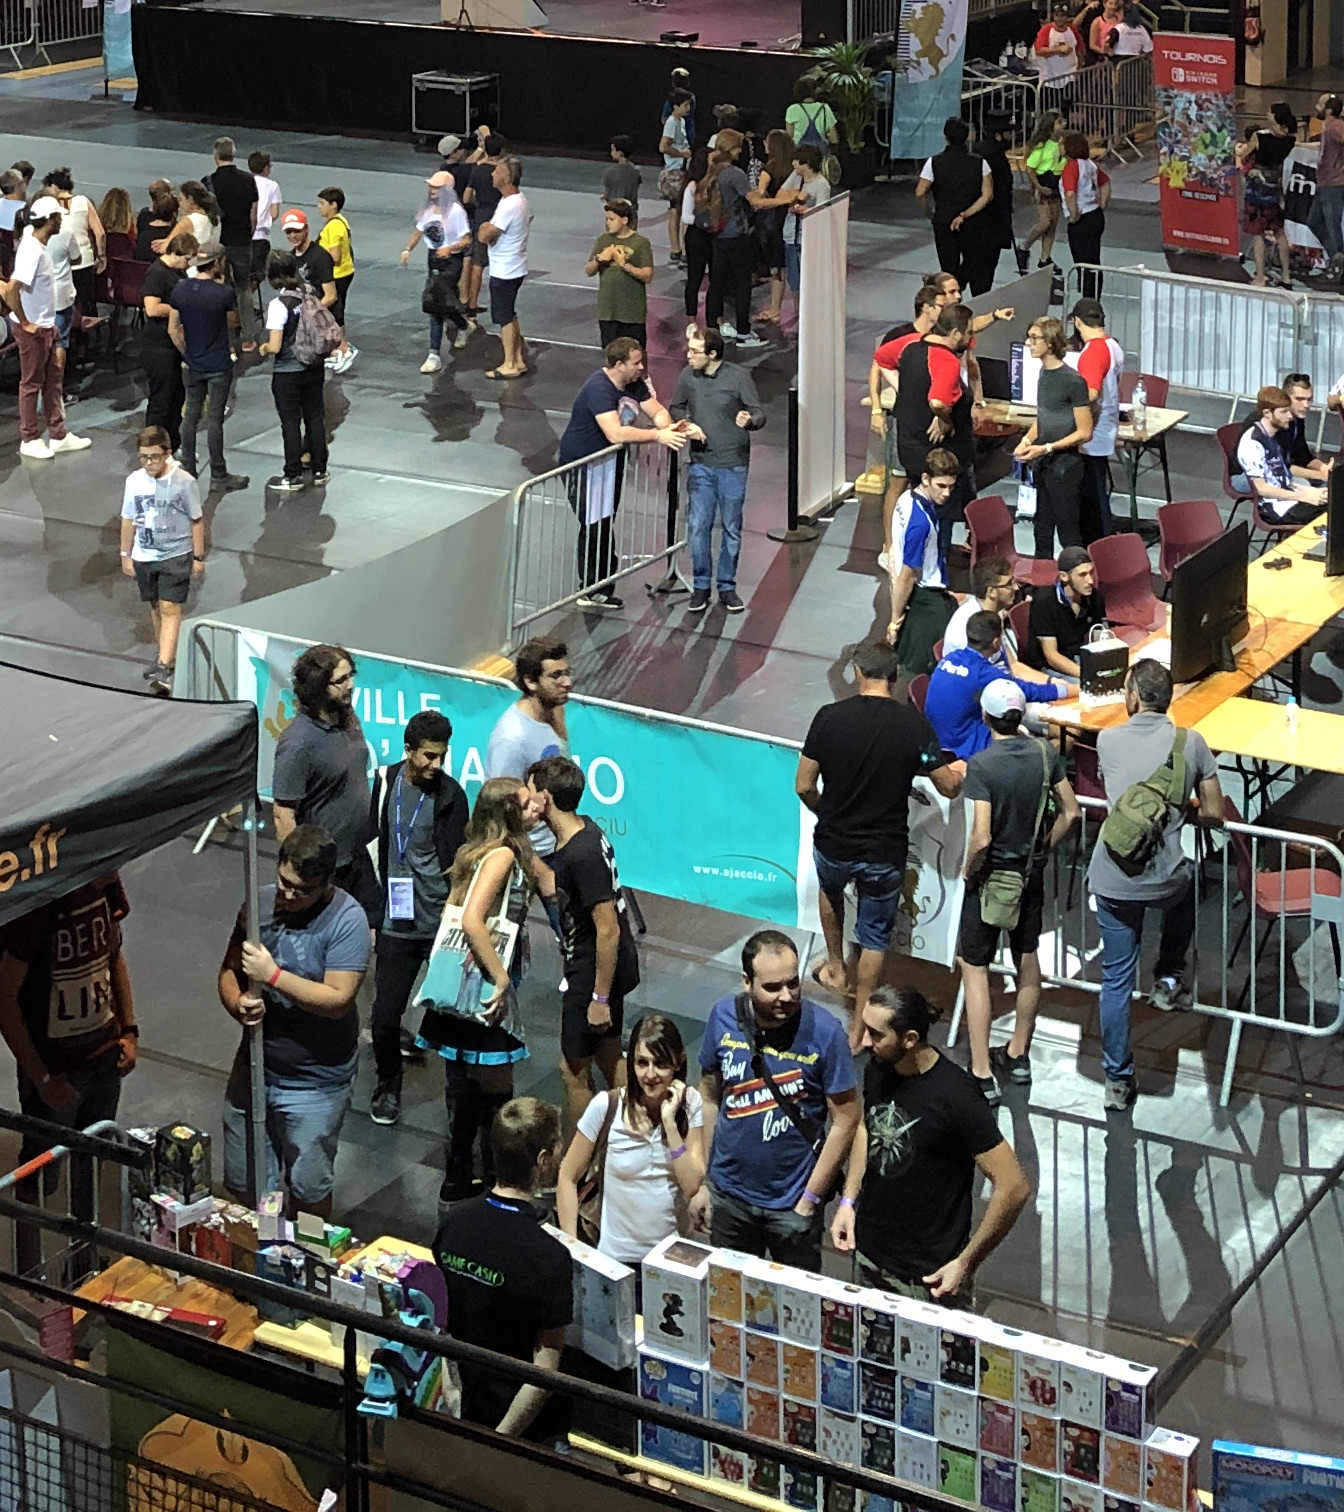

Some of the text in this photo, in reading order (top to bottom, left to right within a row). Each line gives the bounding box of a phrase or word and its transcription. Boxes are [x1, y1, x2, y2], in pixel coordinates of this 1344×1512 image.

[1161, 49, 1228, 65] TOURNOIS
[1288, 173, 1317, 196] fn
[692, 864, 778, 883] www.ajaccio.fr
[57, 916, 107, 962] BER
[440, 1251, 466, 1269] GAME
[1219, 1459, 1294, 1480] MONOPOLY
